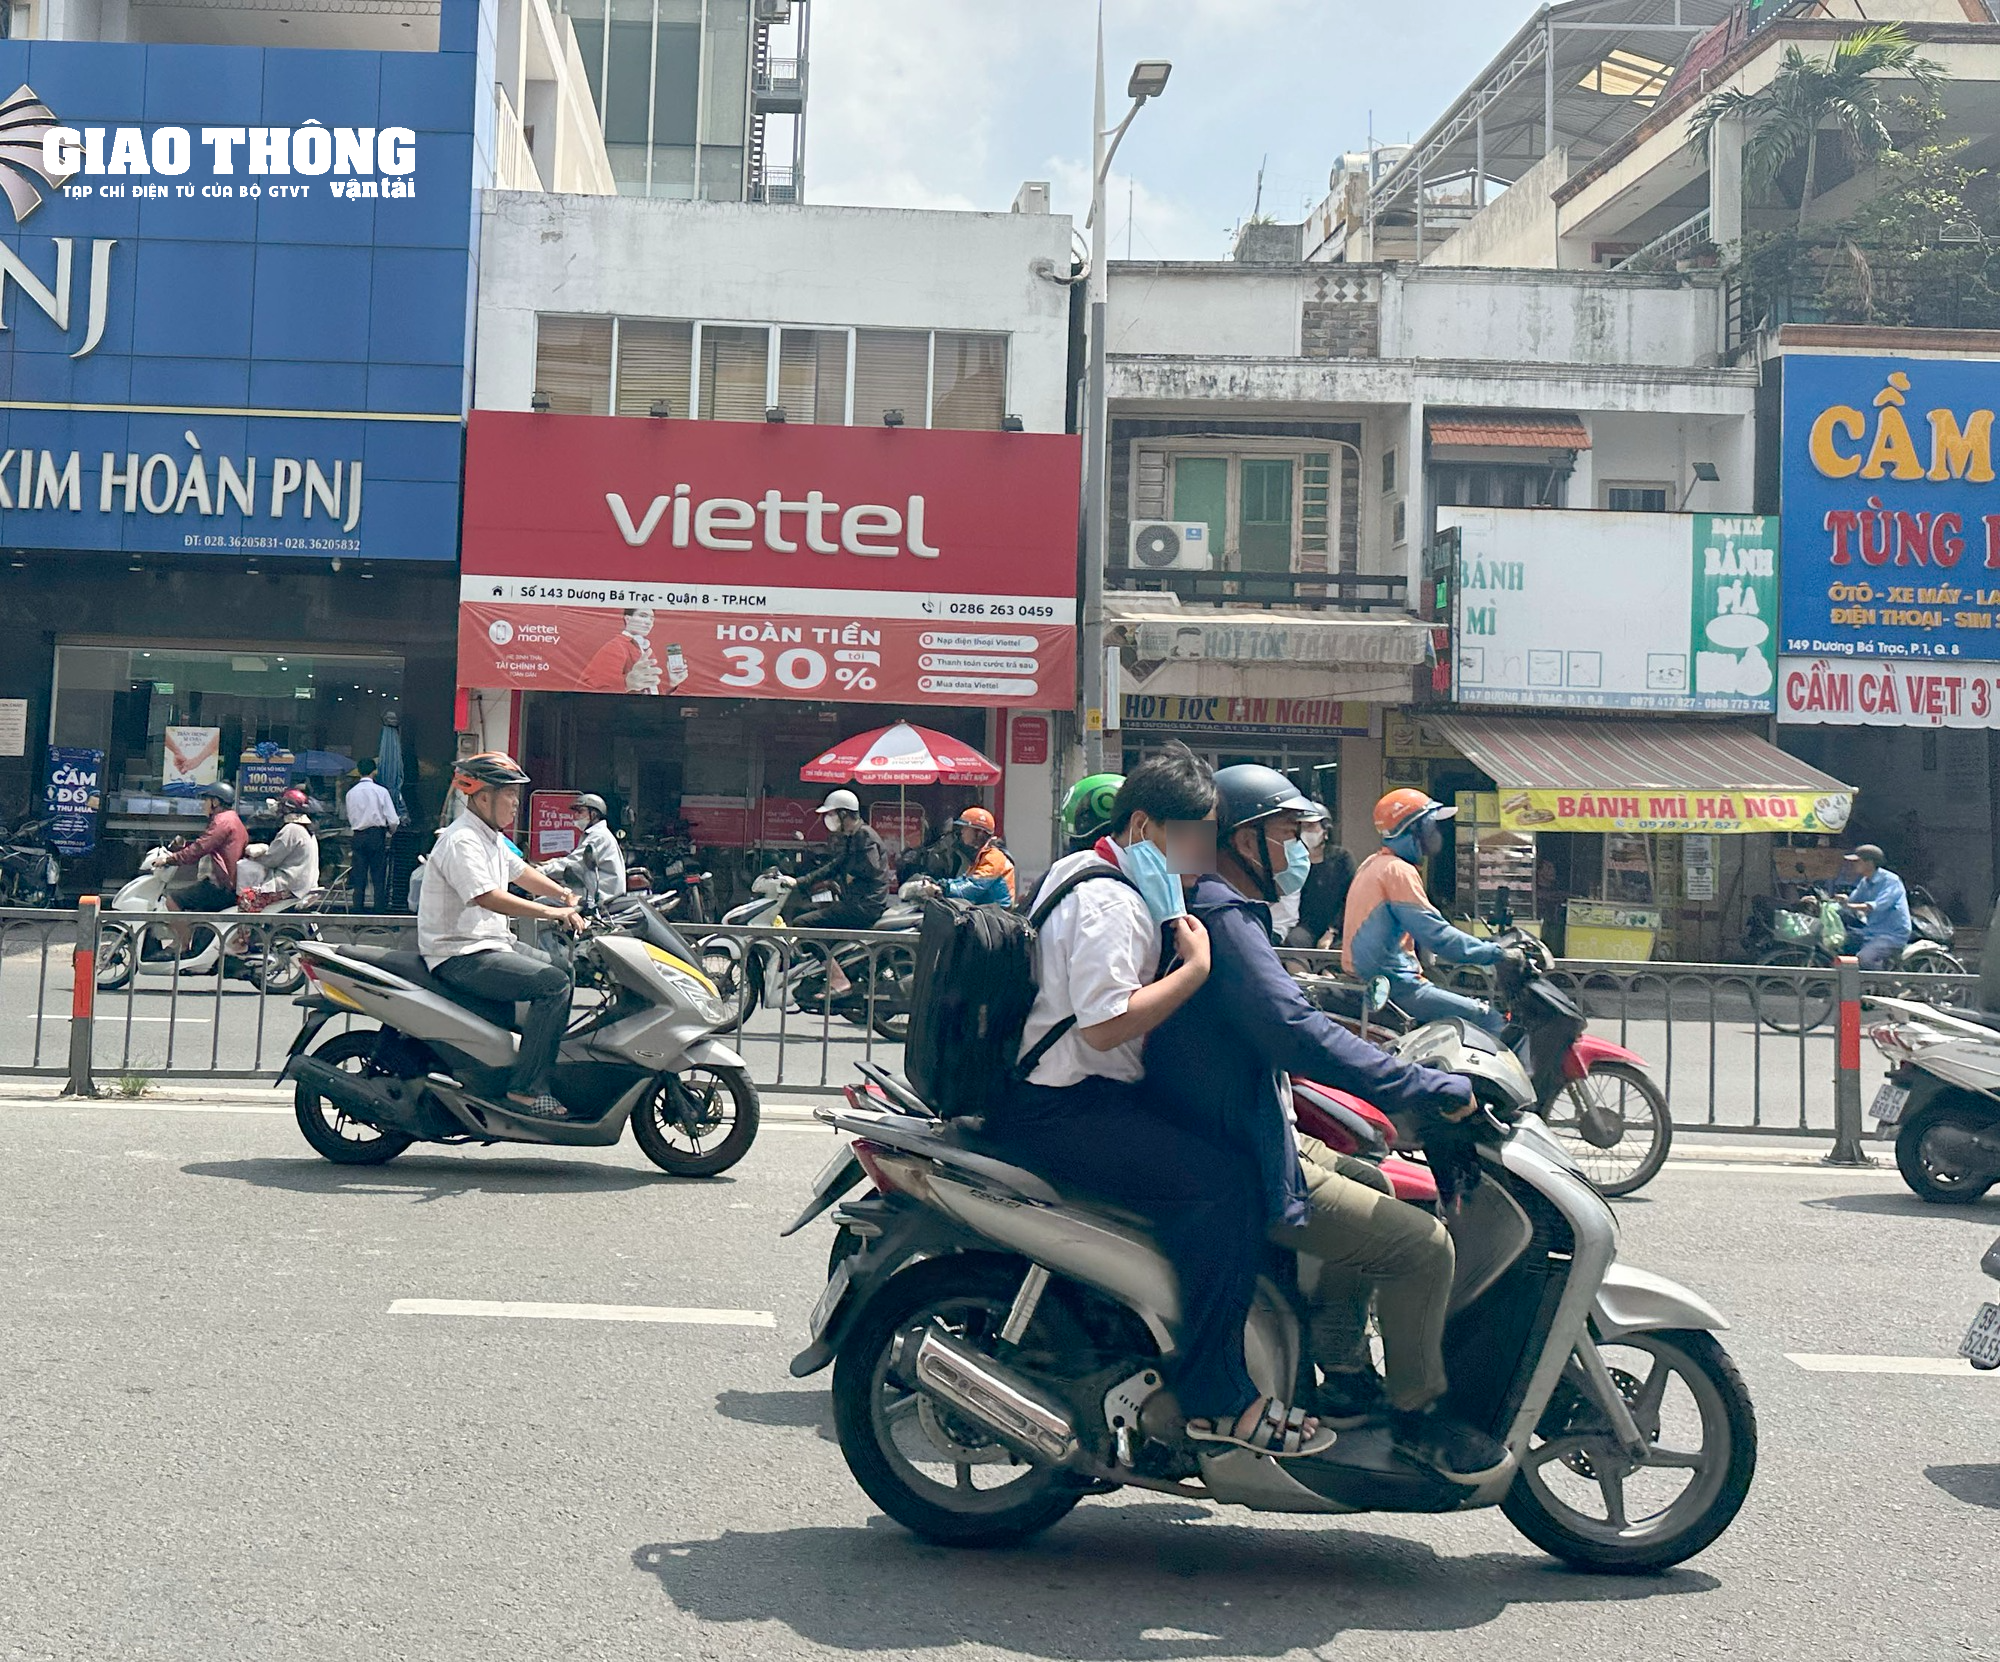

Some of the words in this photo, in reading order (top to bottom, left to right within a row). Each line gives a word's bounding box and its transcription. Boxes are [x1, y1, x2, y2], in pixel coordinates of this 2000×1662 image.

[1809, 371, 1995, 482] CẦM
[0, 449, 81, 510] KIM
[100, 430, 256, 517] HOÀN
[271, 459, 363, 533] PNJ
[605, 483, 940, 559] viettel
[1824, 496, 1964, 567] TÙNG
[185, 535, 201, 547] ĐT:
[1703, 541, 1774, 577] BÁNH
[1460, 551, 1524, 591] BÁNH
[521, 585, 537, 597] Số
[540, 587, 563, 598] 143
[567, 588, 605, 602] Dương
[610, 589, 625, 601] Bá
[629, 591, 654, 603] Trạc
[666, 591, 697, 604] Quận
[702, 594, 709, 604] 8
[722, 594, 766, 606] TP.HCM
[1828, 581, 1873, 602] ÔTÔ
[1888, 586, 1914, 603] XE
[1918, 582, 1961, 604] MÁY
[949, 602, 986, 616] 0286
[990, 603, 1014, 617] 263
[1018, 604, 1054, 618] 0459
[1466, 598, 1497, 636] MÌ
[1831, 604, 1876, 629] ĐIỆN
[1954, 612, 1991, 628] SIM
[518, 623, 559, 634] viettel
[518, 634, 560, 645] money
[717, 621, 801, 643] HOÀN
[812, 622, 880, 645] TIỀN
[937, 637, 952, 645] Nạp
[1788, 639, 1809, 650] 149
[1813, 640, 1854, 655] Dương
[1857, 640, 1874, 652] Bá
[1877, 642, 1909, 656] Trạc,
[849, 651, 865, 660] tới
[937, 658, 962, 666] Thanh
[720, 646, 827, 689] 30
[835, 667, 877, 690] %
[936, 680, 952, 688] Mua
[955, 680, 972, 688] data
[1786, 659, 1851, 711] CẦM
[1858, 663, 1899, 712] CÀ
[1906, 676, 1963, 724] VẸT
[1971, 678, 1989, 716] 3
[1464, 691, 1480, 700] 147
[1731, 699, 1749, 709] 775
[1753, 700, 1770, 710] 732
[52, 766, 97, 787] CẦM
[249, 773, 267, 784] 100
[1557, 793, 1640, 818] BÁNH
[1649, 794, 1688, 819] MÌ
[1697, 795, 1736, 819] HÀ
[1744, 795, 1798, 822] NỘI
[1979, 1308, 2000, 1334] 59-
